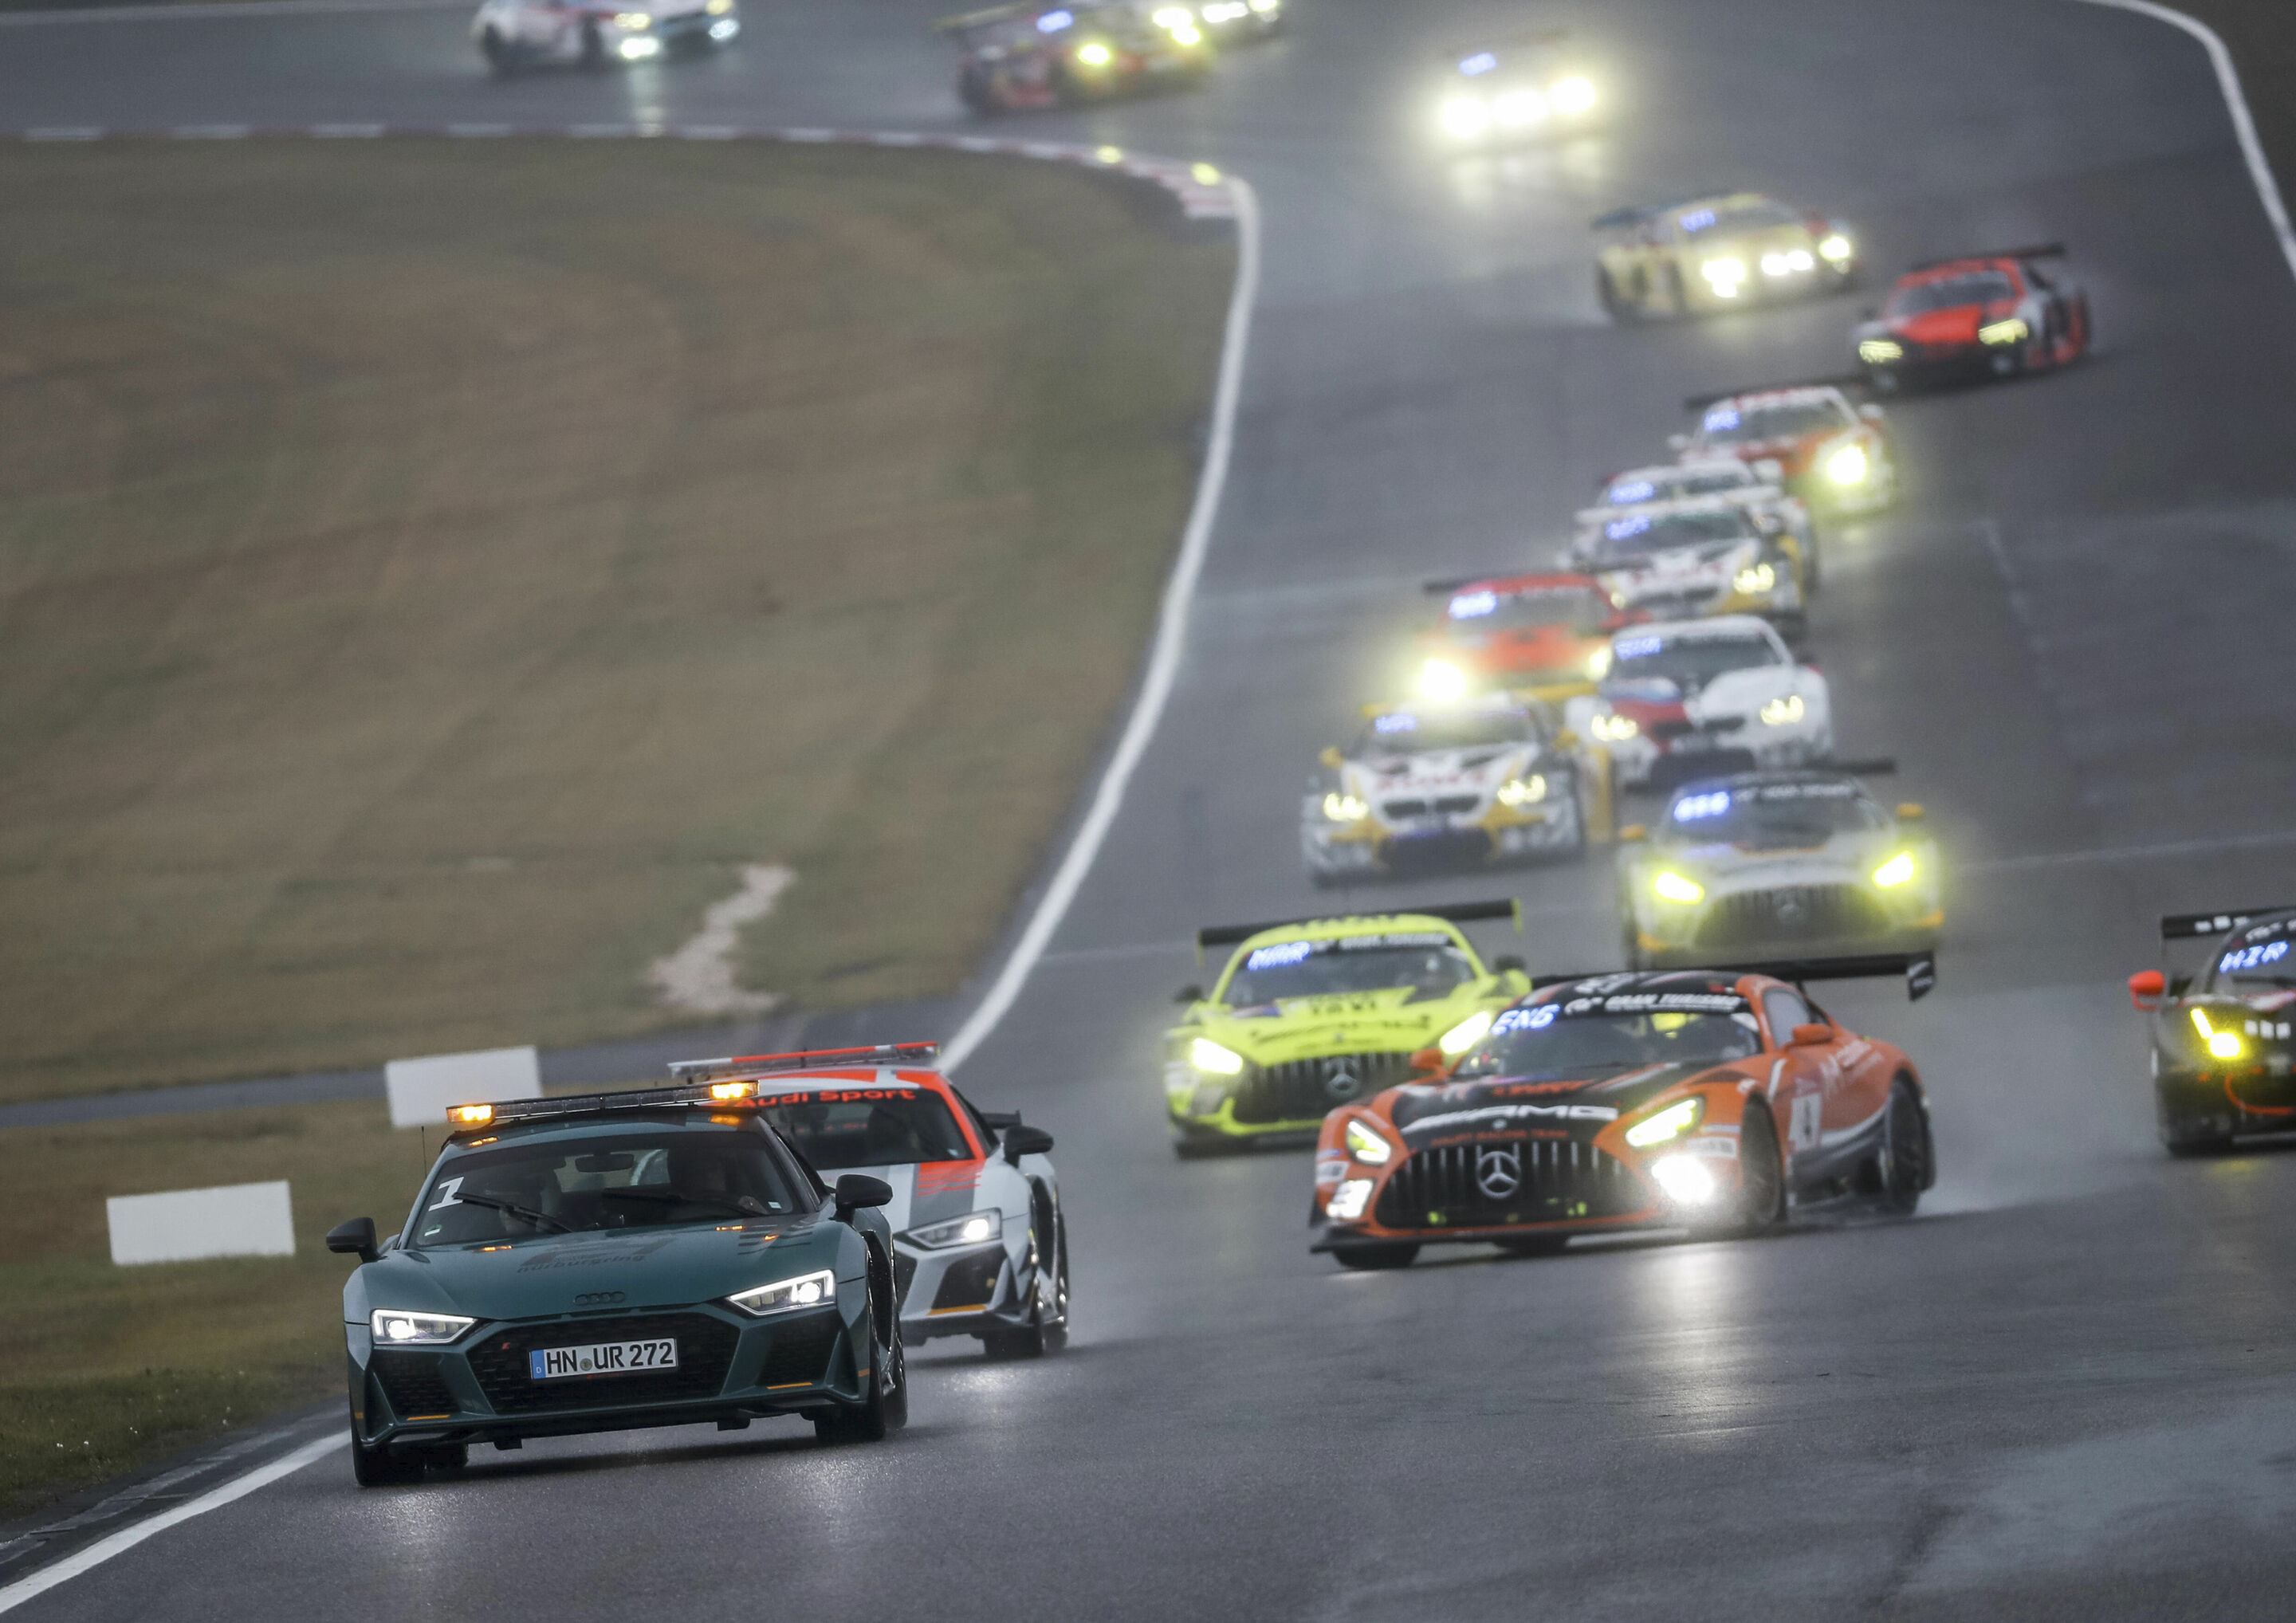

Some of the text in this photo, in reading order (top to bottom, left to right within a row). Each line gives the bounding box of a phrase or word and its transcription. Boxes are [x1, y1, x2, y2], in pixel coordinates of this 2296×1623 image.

[1490, 1003, 1561, 1035] ENG
[735, 1090, 916, 1108] Audi Sport
[429, 1176, 465, 1212] 1
[546, 1342, 674, 1374] HN UR 272
